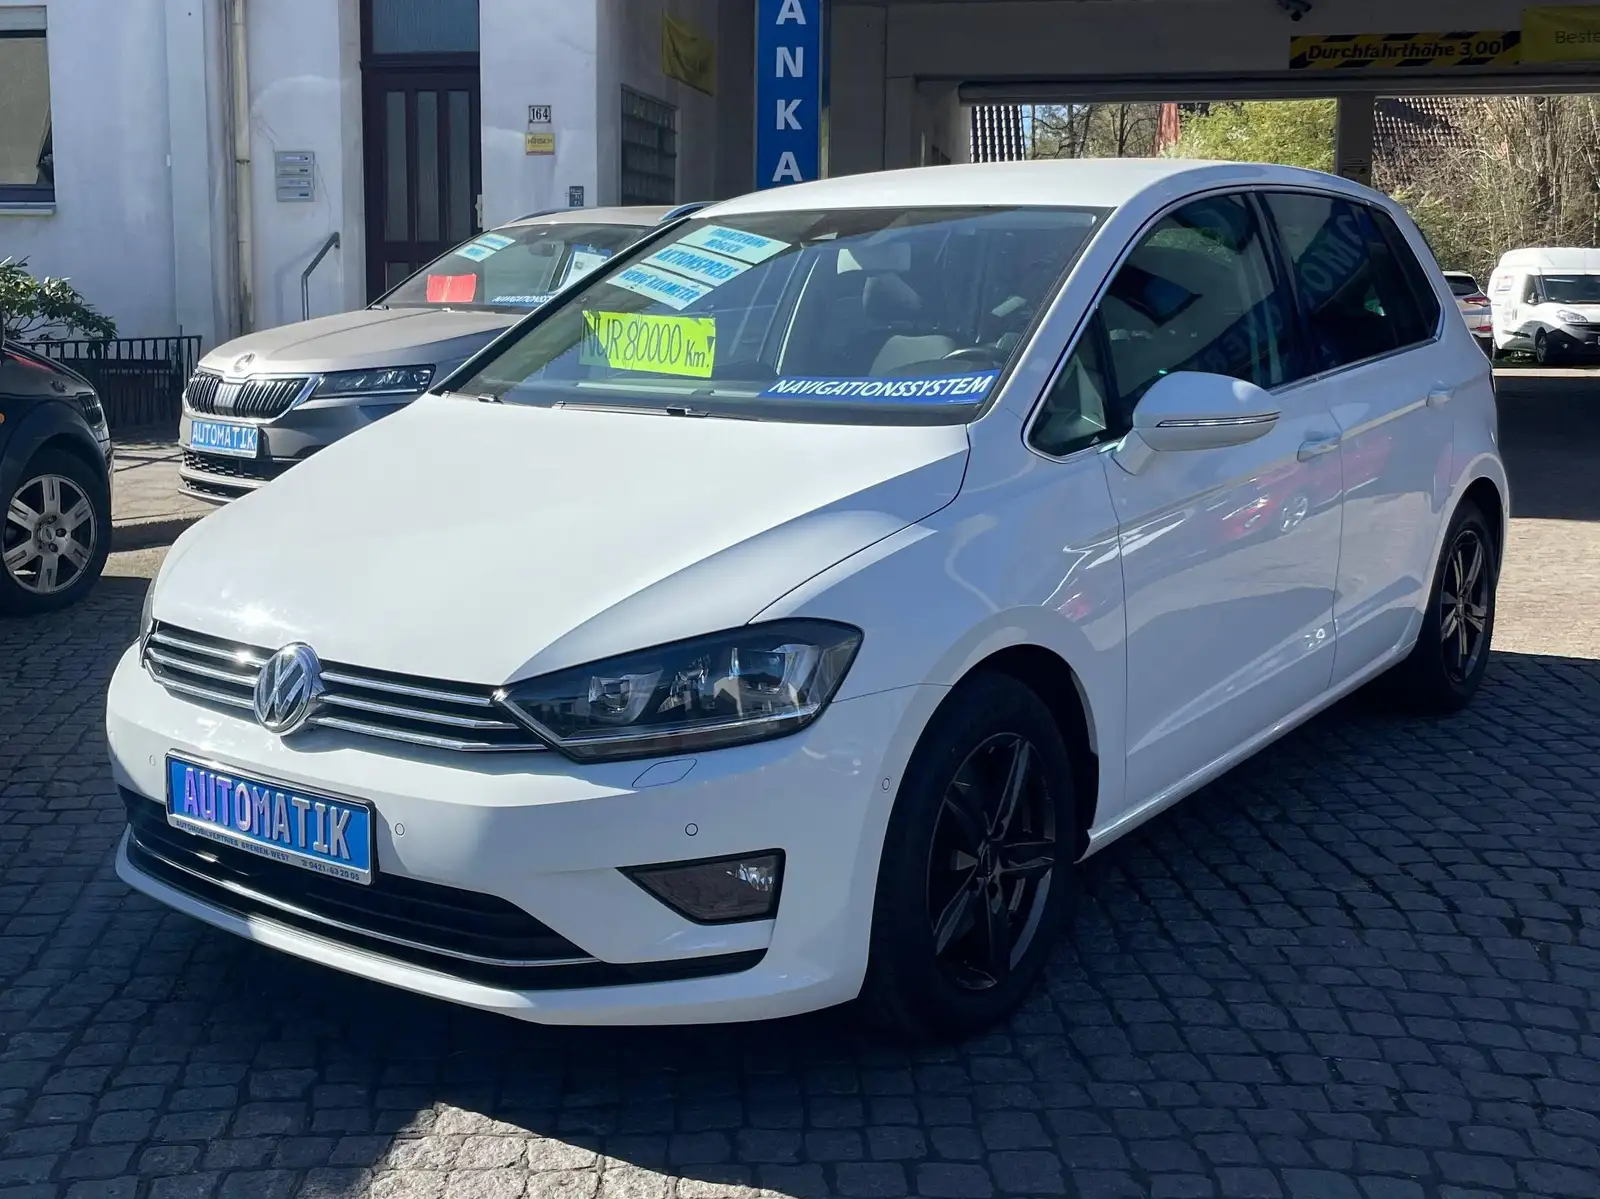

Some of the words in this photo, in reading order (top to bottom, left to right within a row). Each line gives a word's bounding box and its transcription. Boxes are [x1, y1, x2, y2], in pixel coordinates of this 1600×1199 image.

[1555, 30, 1600, 44] Beste
[1307, 42, 1455, 60] Durchfahrthöhe
[1459, 40, 1501, 60] 3,00
[531, 107, 549, 120] 164
[655, 248, 739, 280] AKTIONSPREIS
[581, 317, 623, 360] NUR
[623, 320, 682, 364] 80000
[767, 375, 994, 397] NAVIGATIONSSYSTEM
[192, 421, 257, 450] AUTOMATIK
[184, 767, 350, 860] AUTOMATIK
